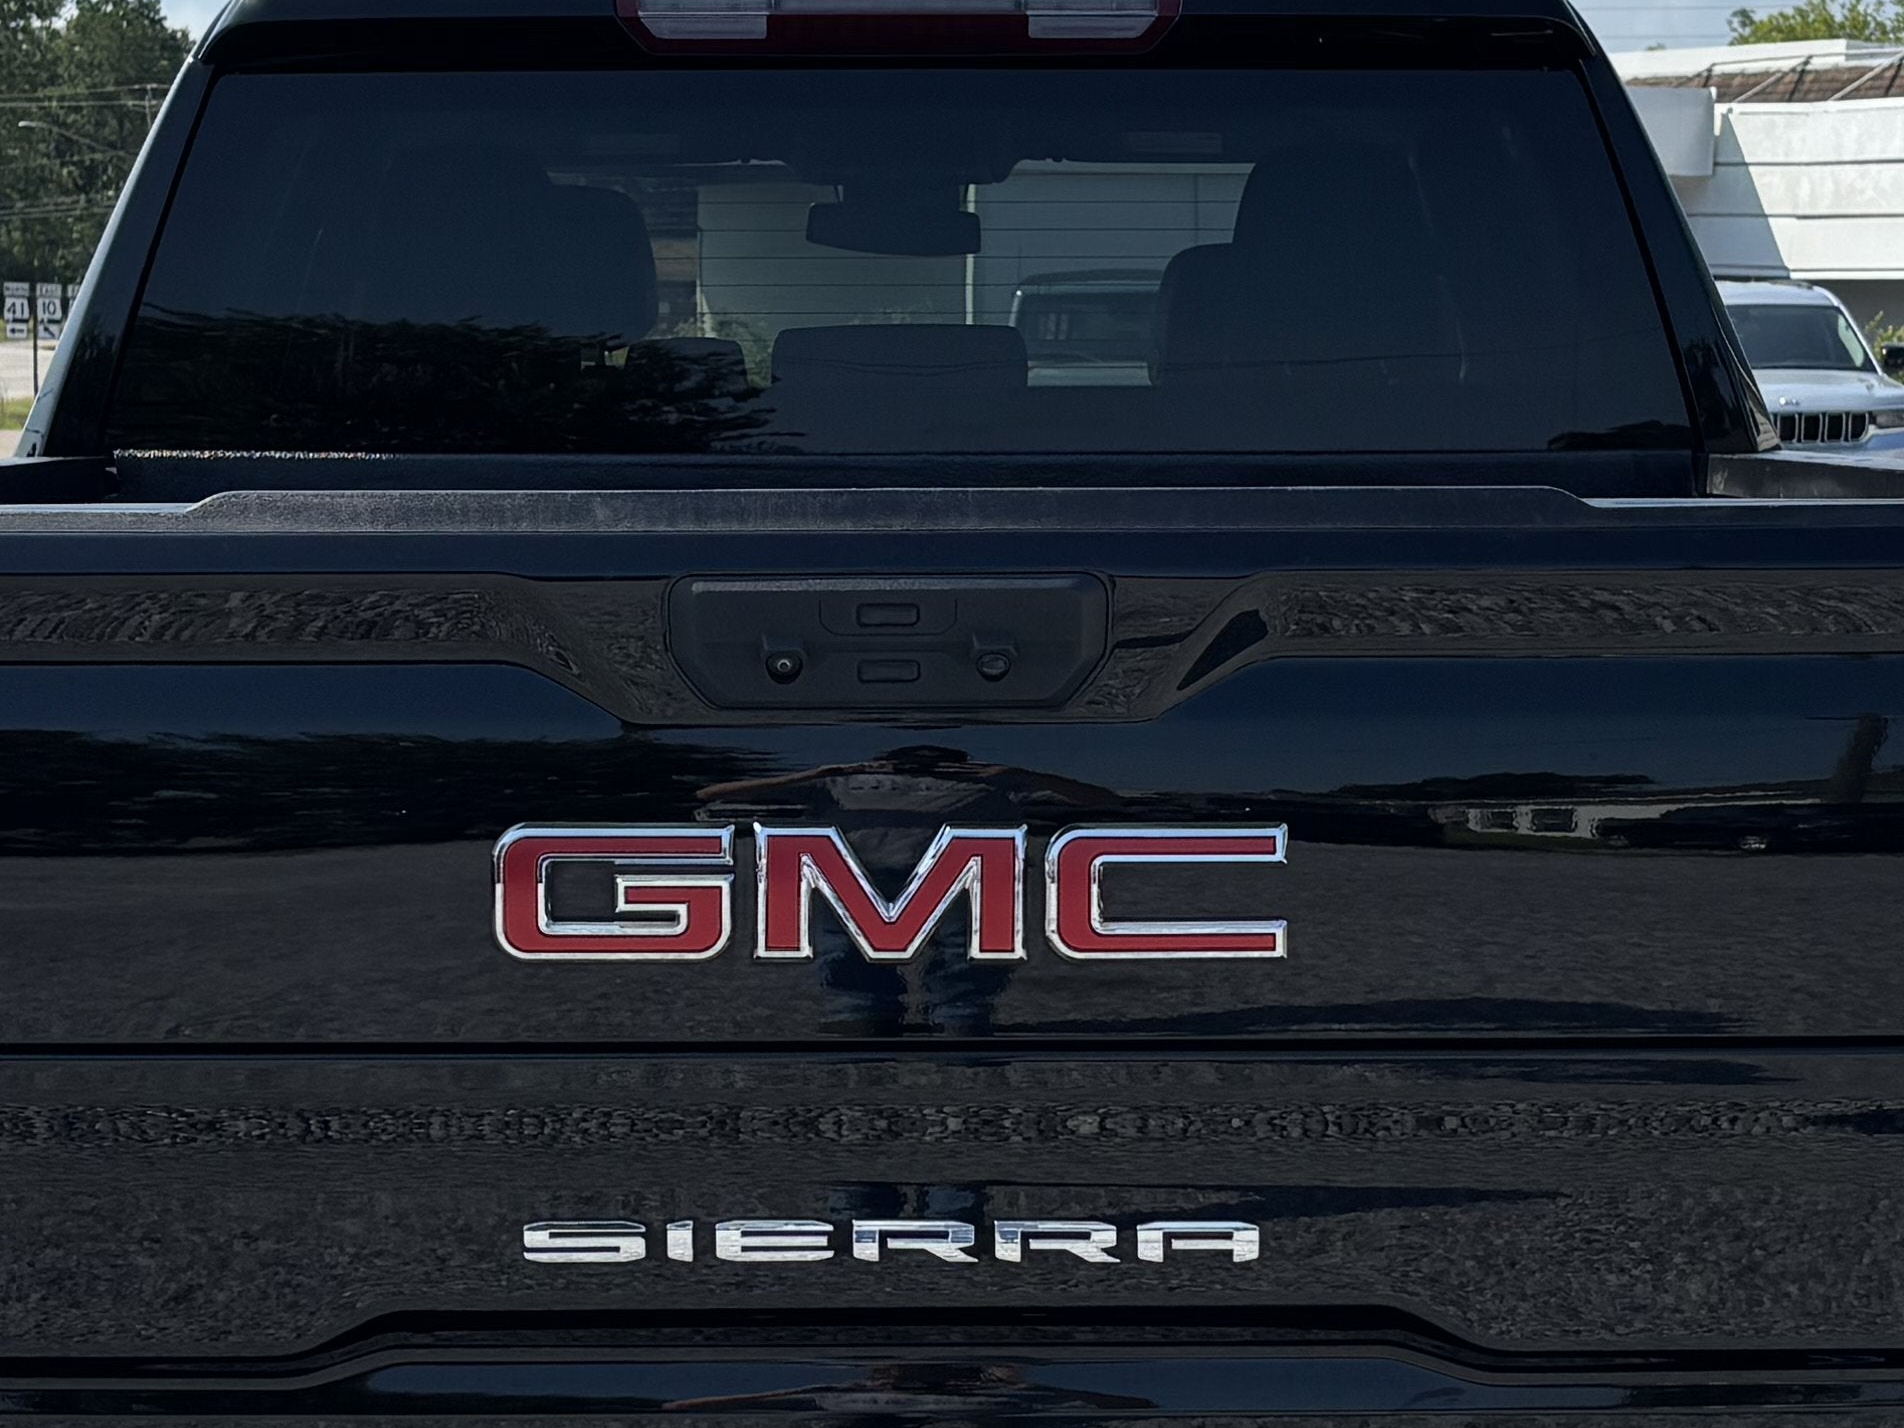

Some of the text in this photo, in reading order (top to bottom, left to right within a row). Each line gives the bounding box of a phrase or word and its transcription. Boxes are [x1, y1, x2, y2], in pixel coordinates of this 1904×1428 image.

[7, 301, 25, 317] 41
[42, 301, 56, 315] 10
[493, 822, 1288, 961] GMC
[522, 1219, 1260, 1263] SIERRA
